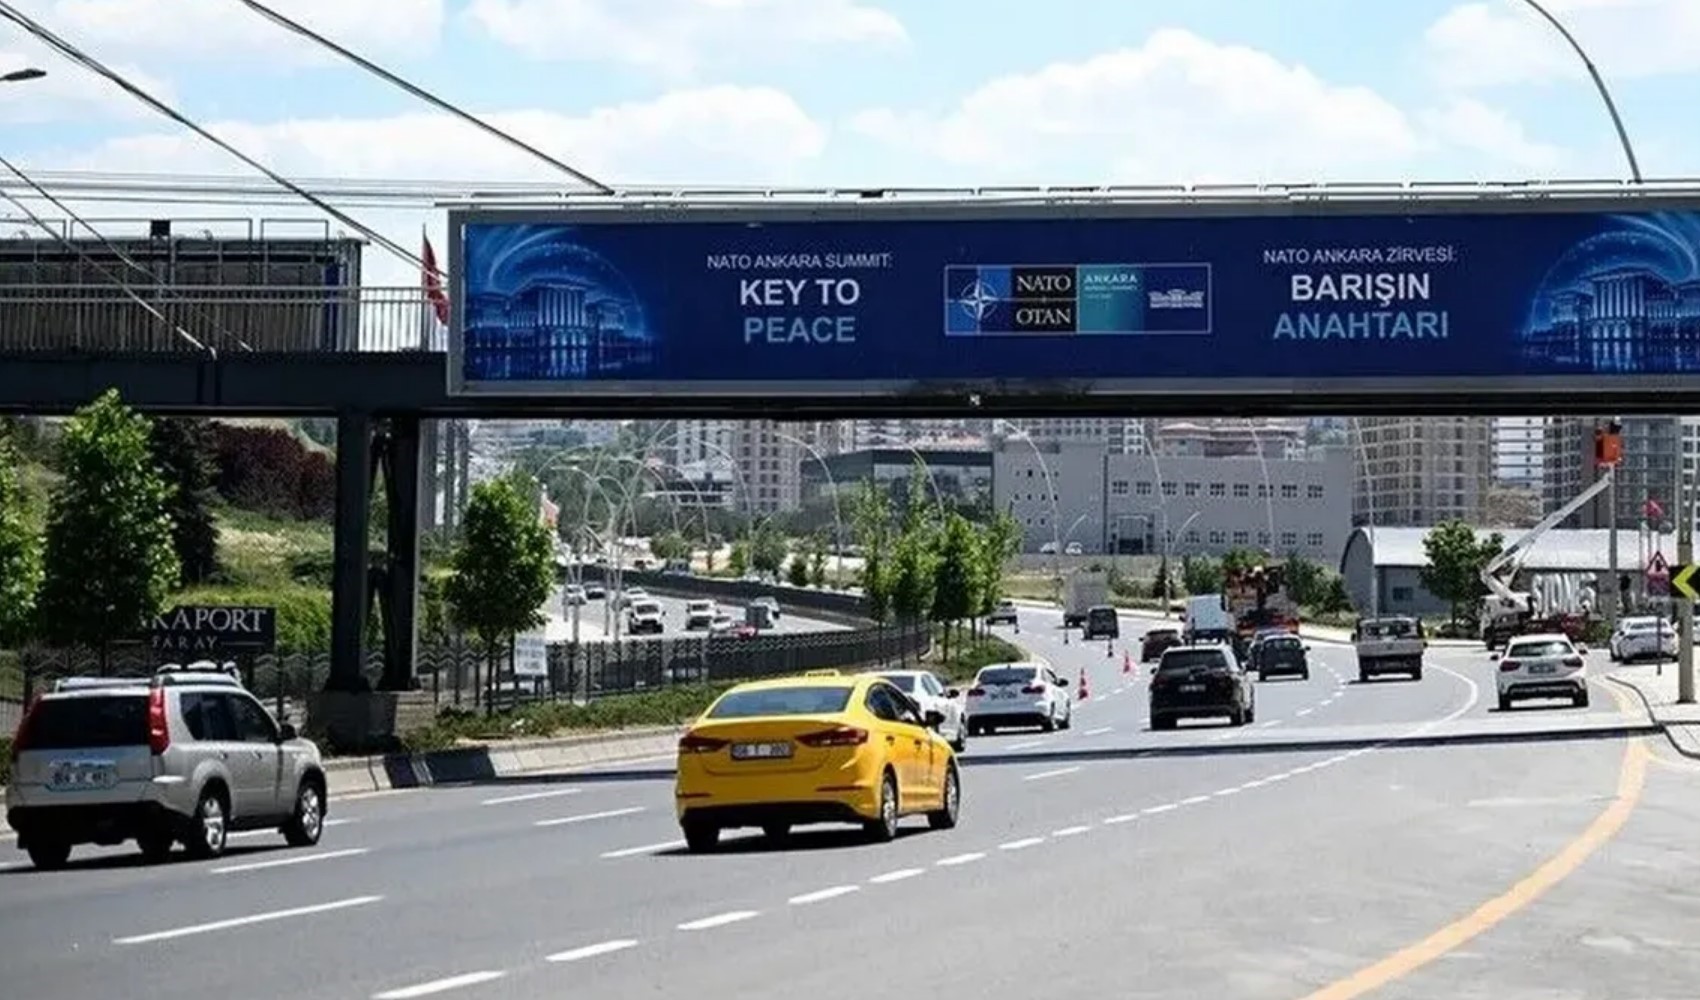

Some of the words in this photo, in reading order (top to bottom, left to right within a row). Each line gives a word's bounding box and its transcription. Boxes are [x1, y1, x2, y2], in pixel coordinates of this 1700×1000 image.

[707, 253, 751, 269] NATO
[754, 253, 822, 269] ANKARA
[824, 252, 893, 268] SUMMIT:
[1263, 248, 1310, 263] NATO
[1312, 247, 1384, 262] ANKARA
[1016, 274, 1071, 292] NATO
[1084, 273, 1138, 284] ANKARA
[740, 279, 807, 305] KEY
[814, 278, 861, 305] TO
[1290, 272, 1430, 307] BARIŞIN
[1016, 308, 1071, 326] OTAN
[1273, 311, 1449, 340] ANAHTARI
[744, 316, 857, 344] PEACE
